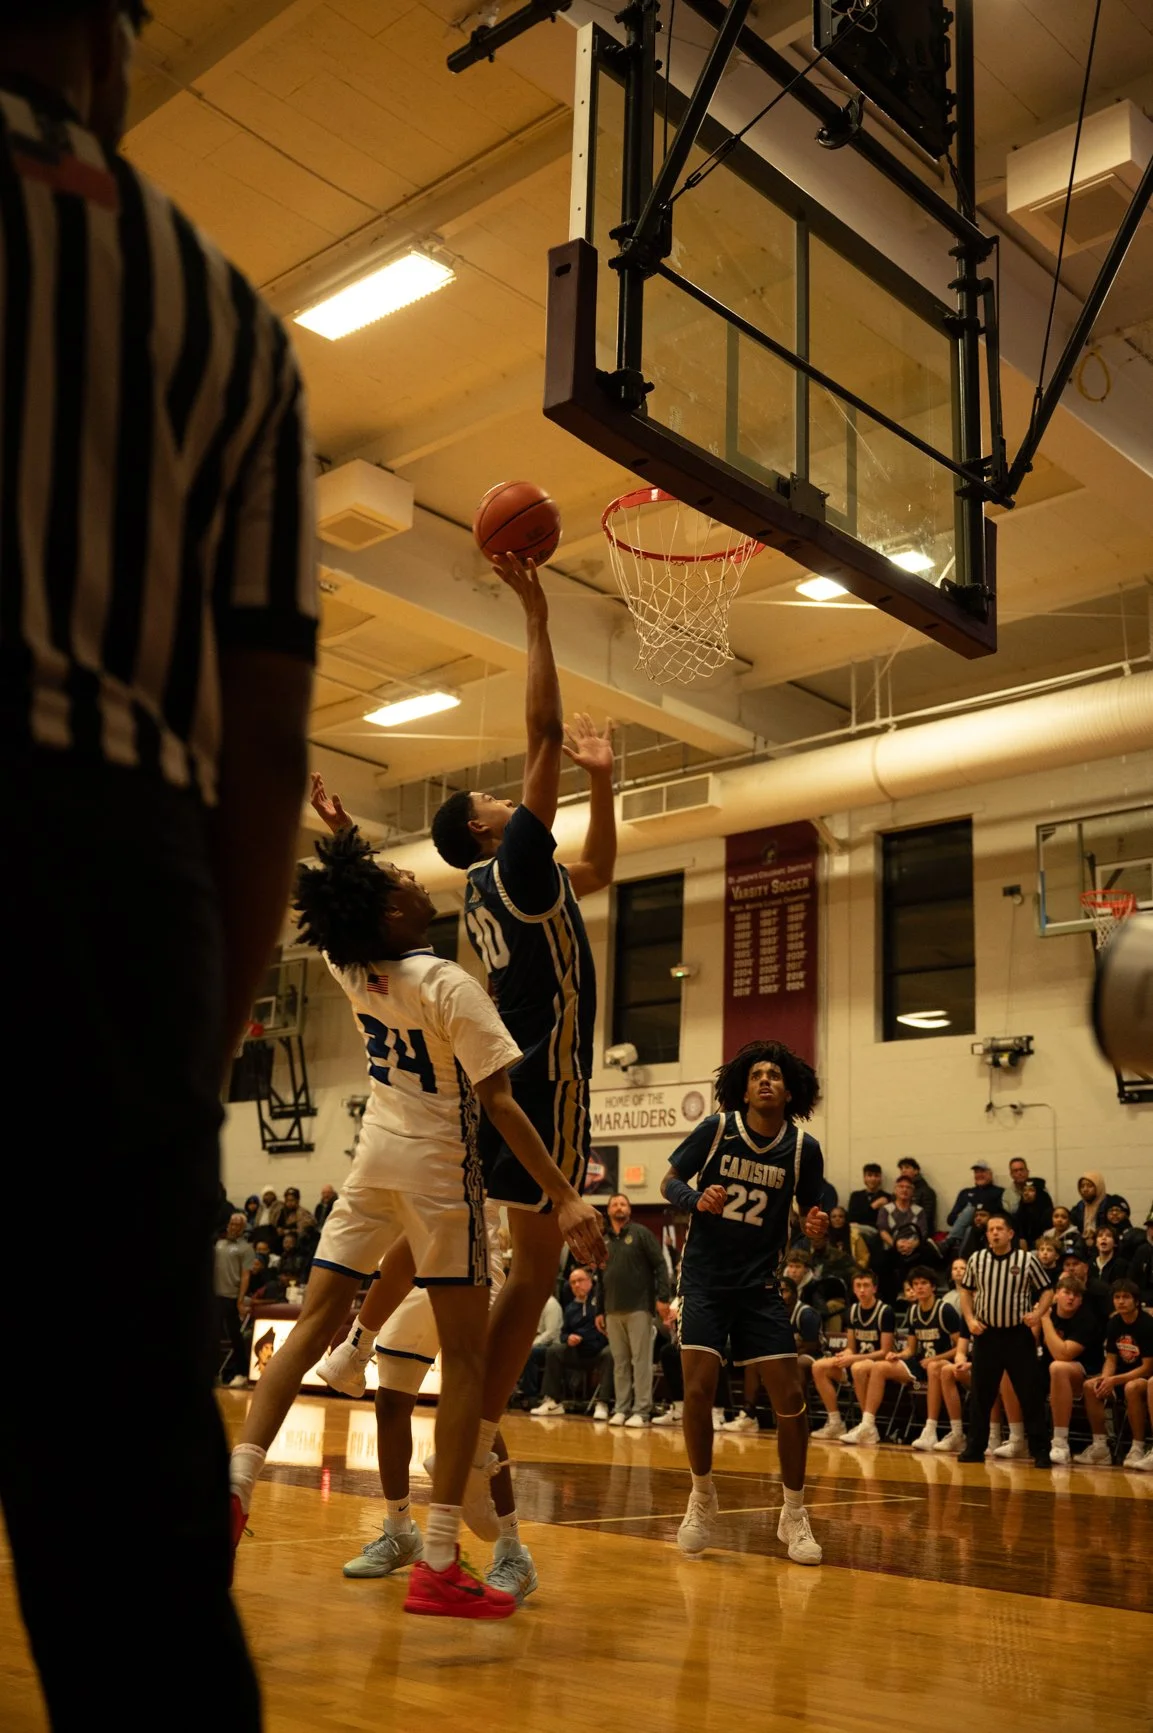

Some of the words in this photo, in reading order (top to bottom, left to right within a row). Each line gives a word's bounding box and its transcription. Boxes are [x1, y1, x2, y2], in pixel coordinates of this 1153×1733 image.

[731, 884, 769, 901] VARSITY
[771, 876, 809, 894] SOCCER
[357, 1013, 438, 1094] 24
[605, 1095, 630, 1108] HOME
[632, 1093, 644, 1106] OF
[648, 1091, 665, 1104] THE
[592, 1108, 677, 1131] MARAUDERS
[720, 1154, 786, 1189] CANISIUS
[722, 1183, 768, 1227] 22
